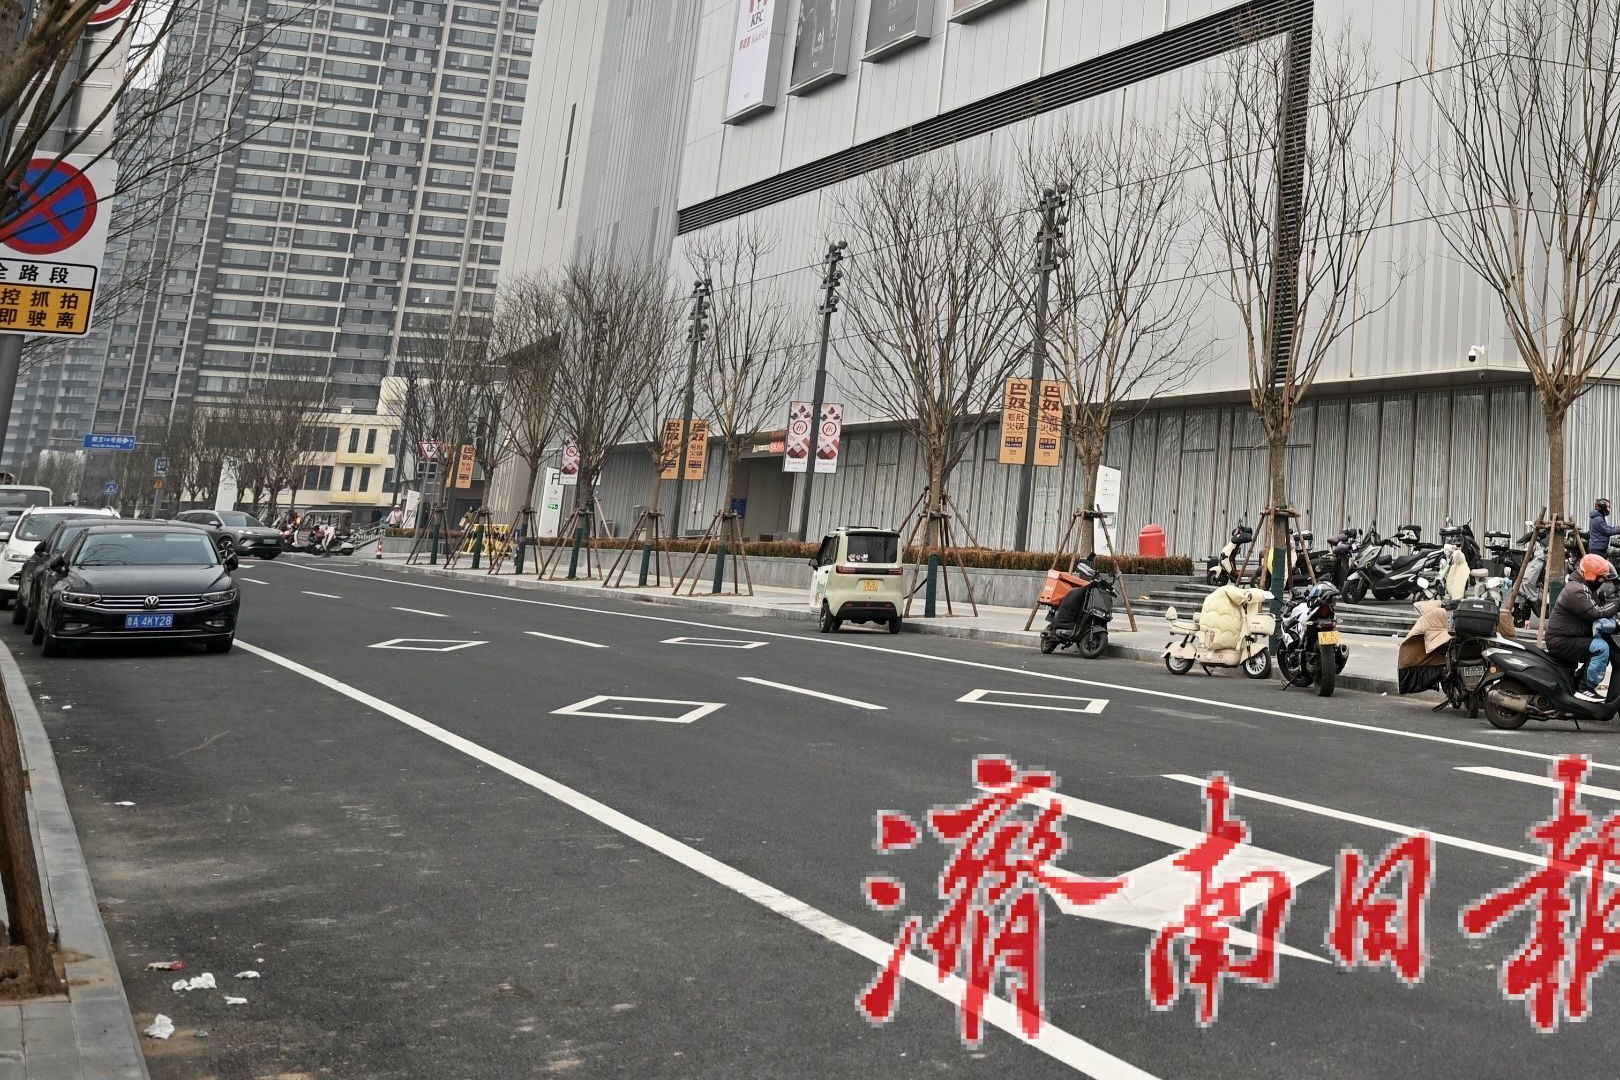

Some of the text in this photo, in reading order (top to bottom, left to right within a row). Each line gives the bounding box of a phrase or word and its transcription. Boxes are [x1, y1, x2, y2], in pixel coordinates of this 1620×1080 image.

[1, 287, 79, 309] 控抓拍
[0, 308, 76, 329] 即驶离
[1008, 383, 1027, 410] 巴奴
[1042, 385, 1060, 412] 巴奴
